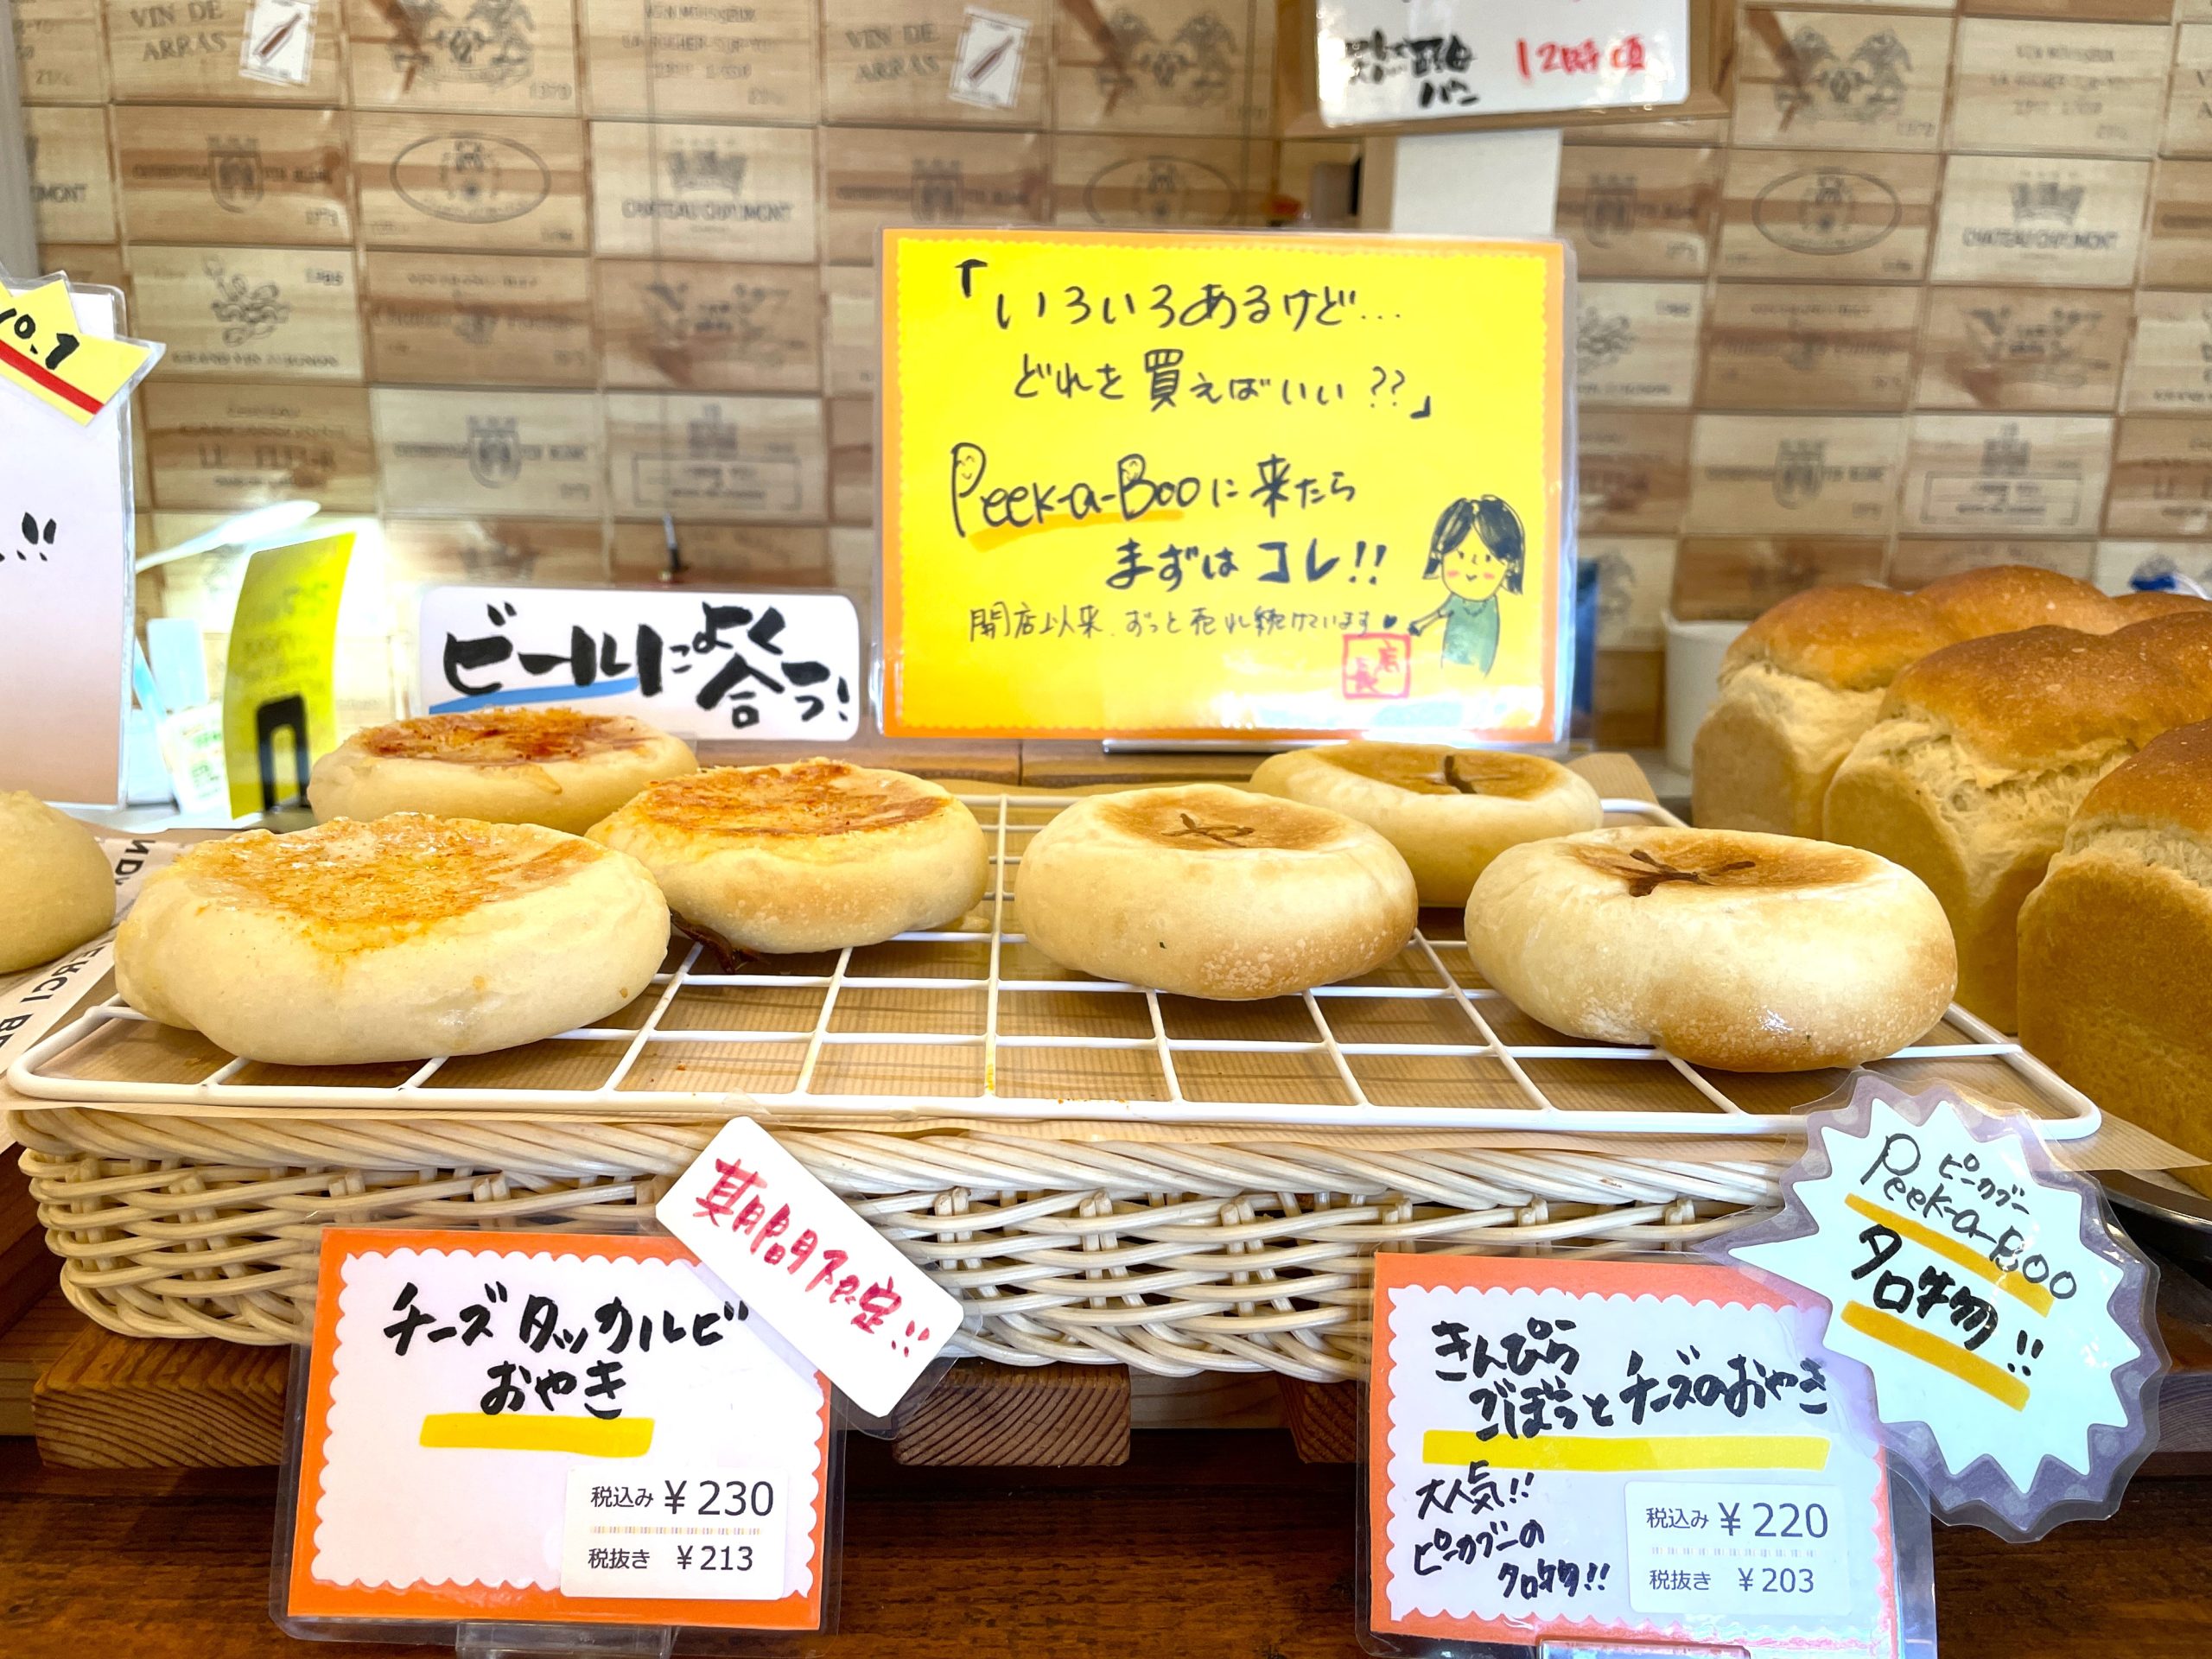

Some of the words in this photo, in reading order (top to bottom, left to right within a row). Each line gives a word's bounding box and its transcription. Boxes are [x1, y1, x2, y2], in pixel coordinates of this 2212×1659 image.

[480, 1360, 627, 1420] おやき
[591, 1485, 654, 1510] 税込み
[1646, 1507, 1710, 1530] 税込み
[588, 1548, 651, 1571] 税抜き
[1649, 1568, 1712, 1592] 税抜き
